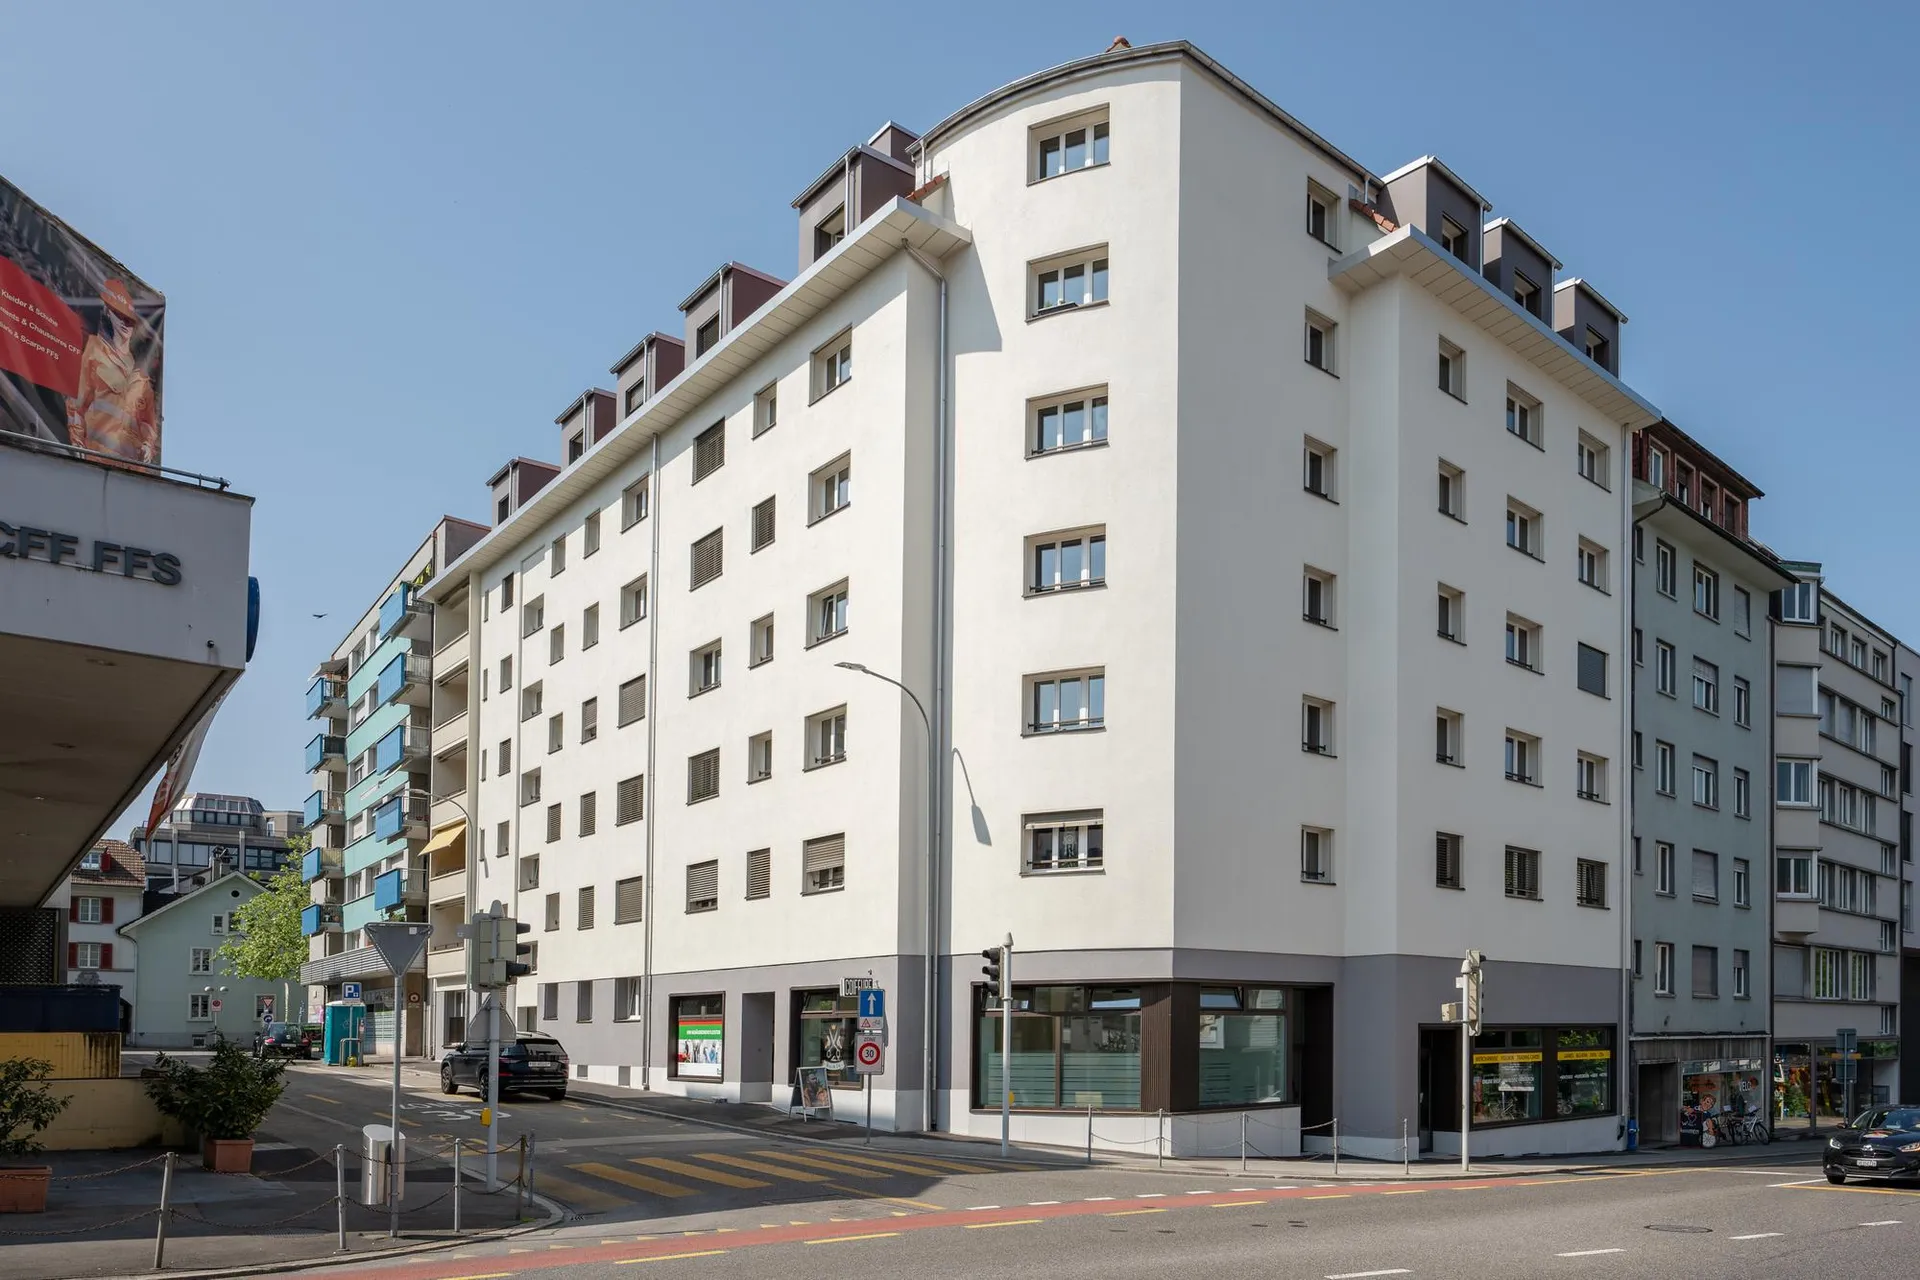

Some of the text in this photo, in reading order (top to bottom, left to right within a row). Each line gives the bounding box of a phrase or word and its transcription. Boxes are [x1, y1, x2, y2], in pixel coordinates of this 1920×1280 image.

[1, 289, 27, 308] Kleider
[28, 304, 34, 313] &
[20, 334, 45, 352] Scarpe
[46, 348, 59, 360] FFS
[21, 318, 27, 326] &
[29, 322, 67, 348] Chaussures
[68, 344, 81, 355] CFF
[93, 540, 182, 585] FFS
[864, 1049, 875, 1059] 30
